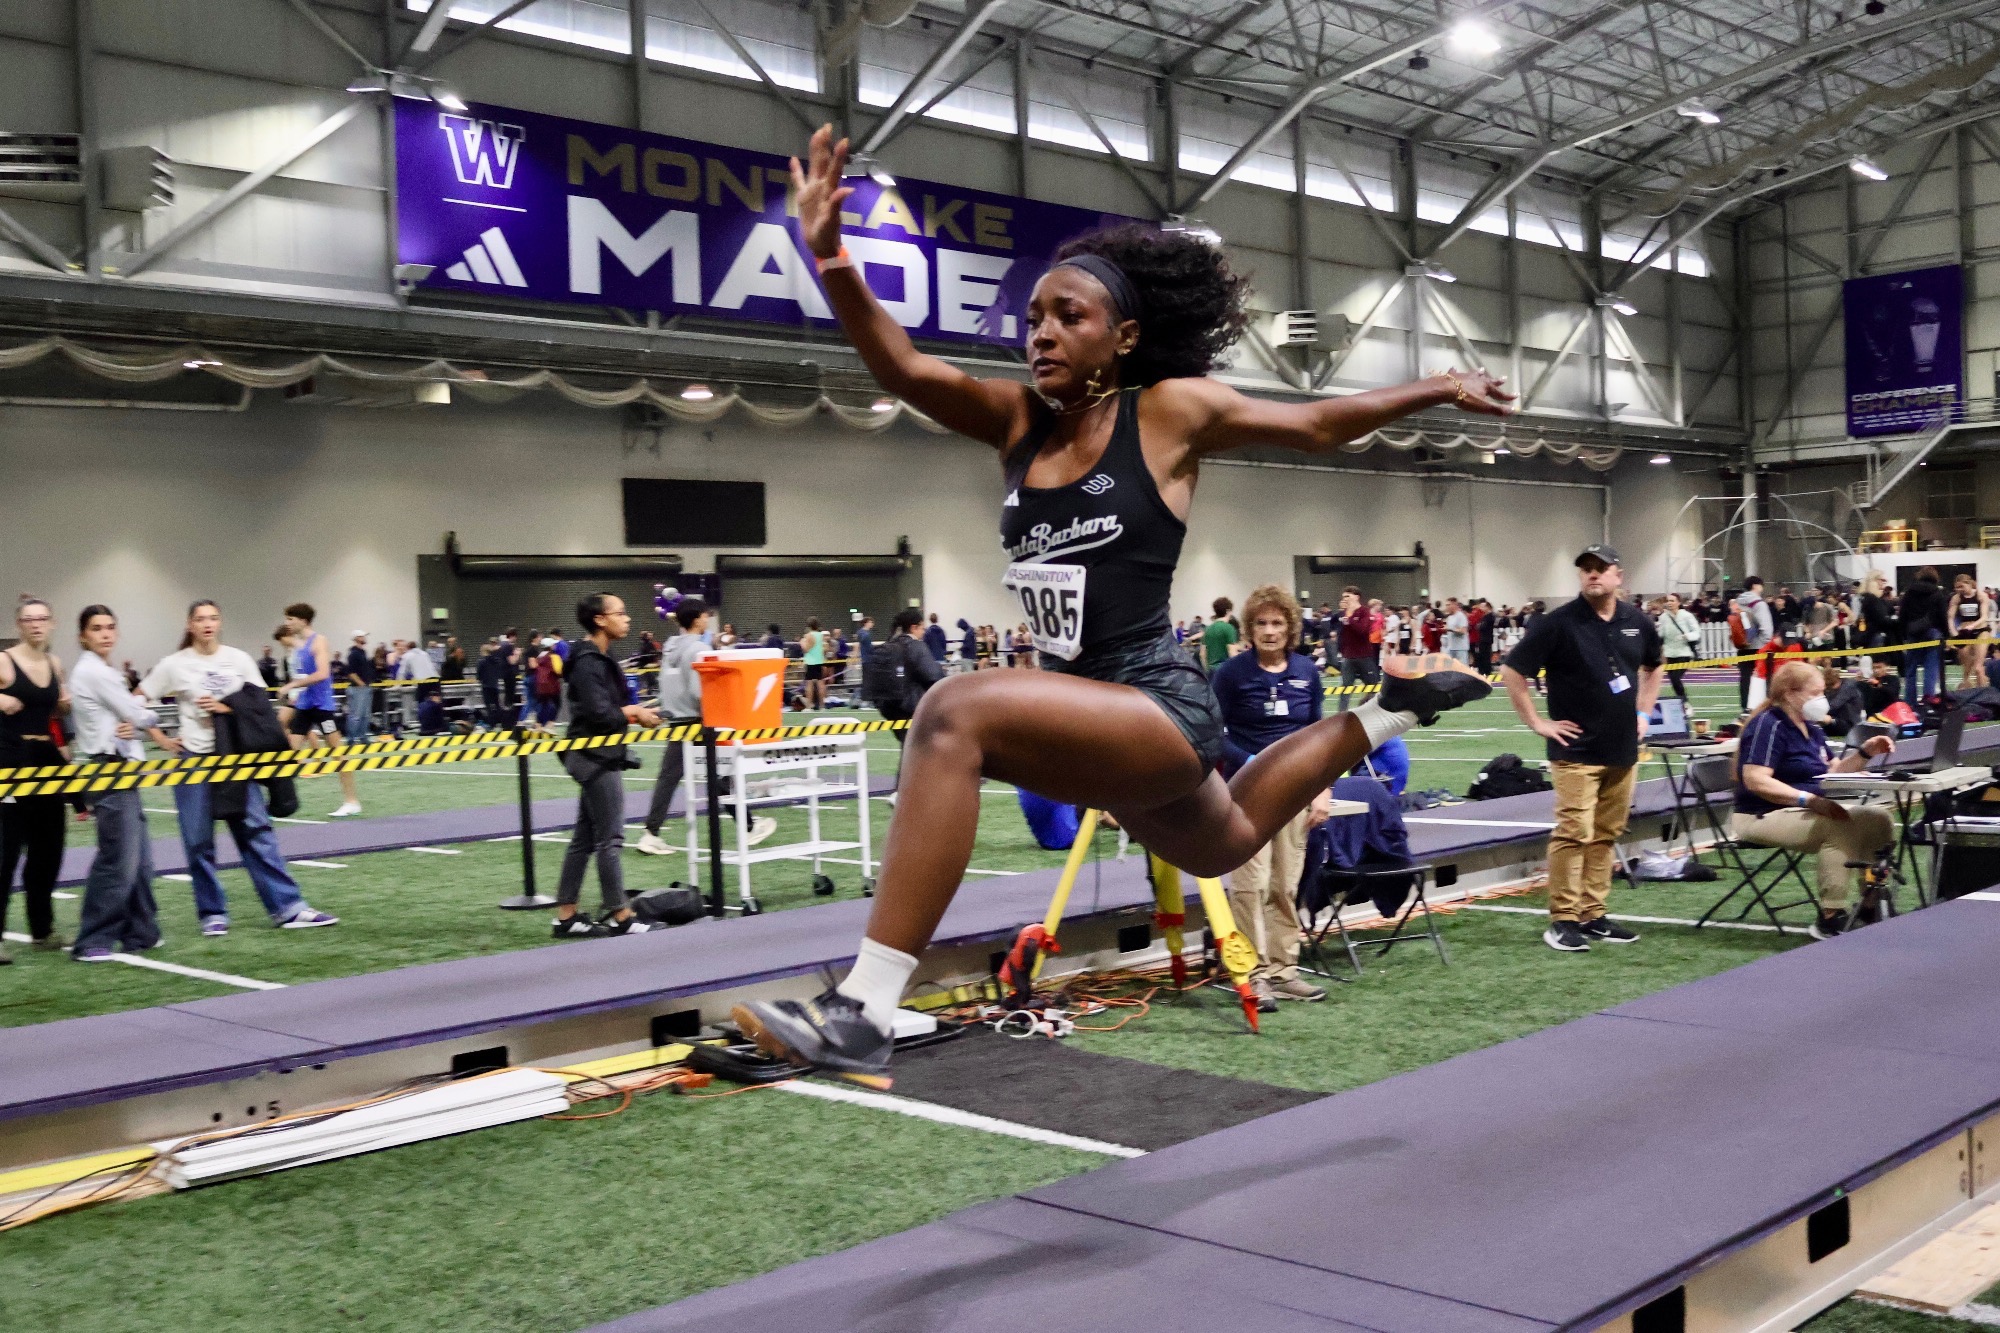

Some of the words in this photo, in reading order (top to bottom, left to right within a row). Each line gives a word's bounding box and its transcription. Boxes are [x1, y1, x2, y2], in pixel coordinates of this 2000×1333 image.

[438, 112, 526, 190] W
[567, 194, 1018, 340] MADE
[1851, 383, 1957, 402] CONFERENCE
[1006, 584, 1078, 642] 985
